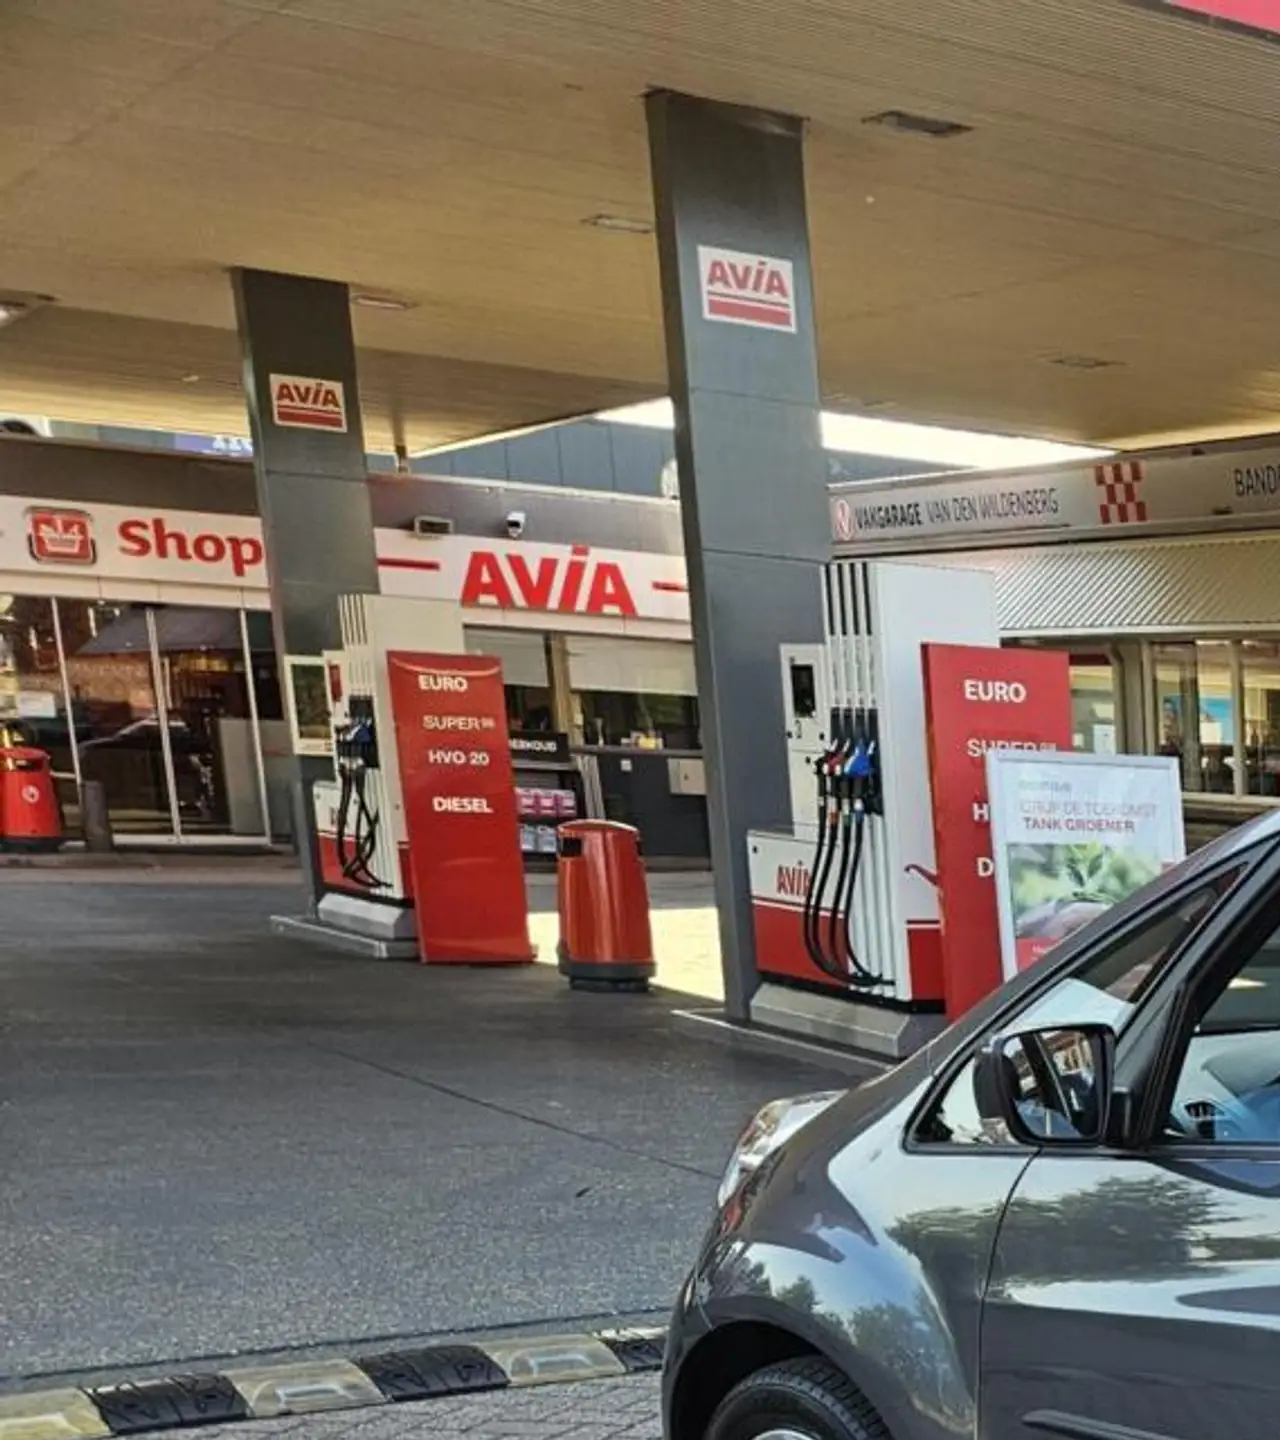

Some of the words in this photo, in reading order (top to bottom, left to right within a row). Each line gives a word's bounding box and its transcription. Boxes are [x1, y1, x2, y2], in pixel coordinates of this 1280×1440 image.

[855, 501, 923, 530] VAKGARAGE
[927, 499, 950, 524] VAN
[953, 496, 978, 522] DEN
[980, 487, 1061, 520] WILDENBERG
[117, 518, 264, 578] Shop
[418, 675, 468, 692] EURO
[964, 679, 1027, 703] EURO
[423, 714, 481, 731] SUPER
[429, 750, 466, 764] HVO
[470, 752, 490, 766] 20
[432, 796, 494, 814] DIESEL
[1023, 816, 1062, 831] TANK
